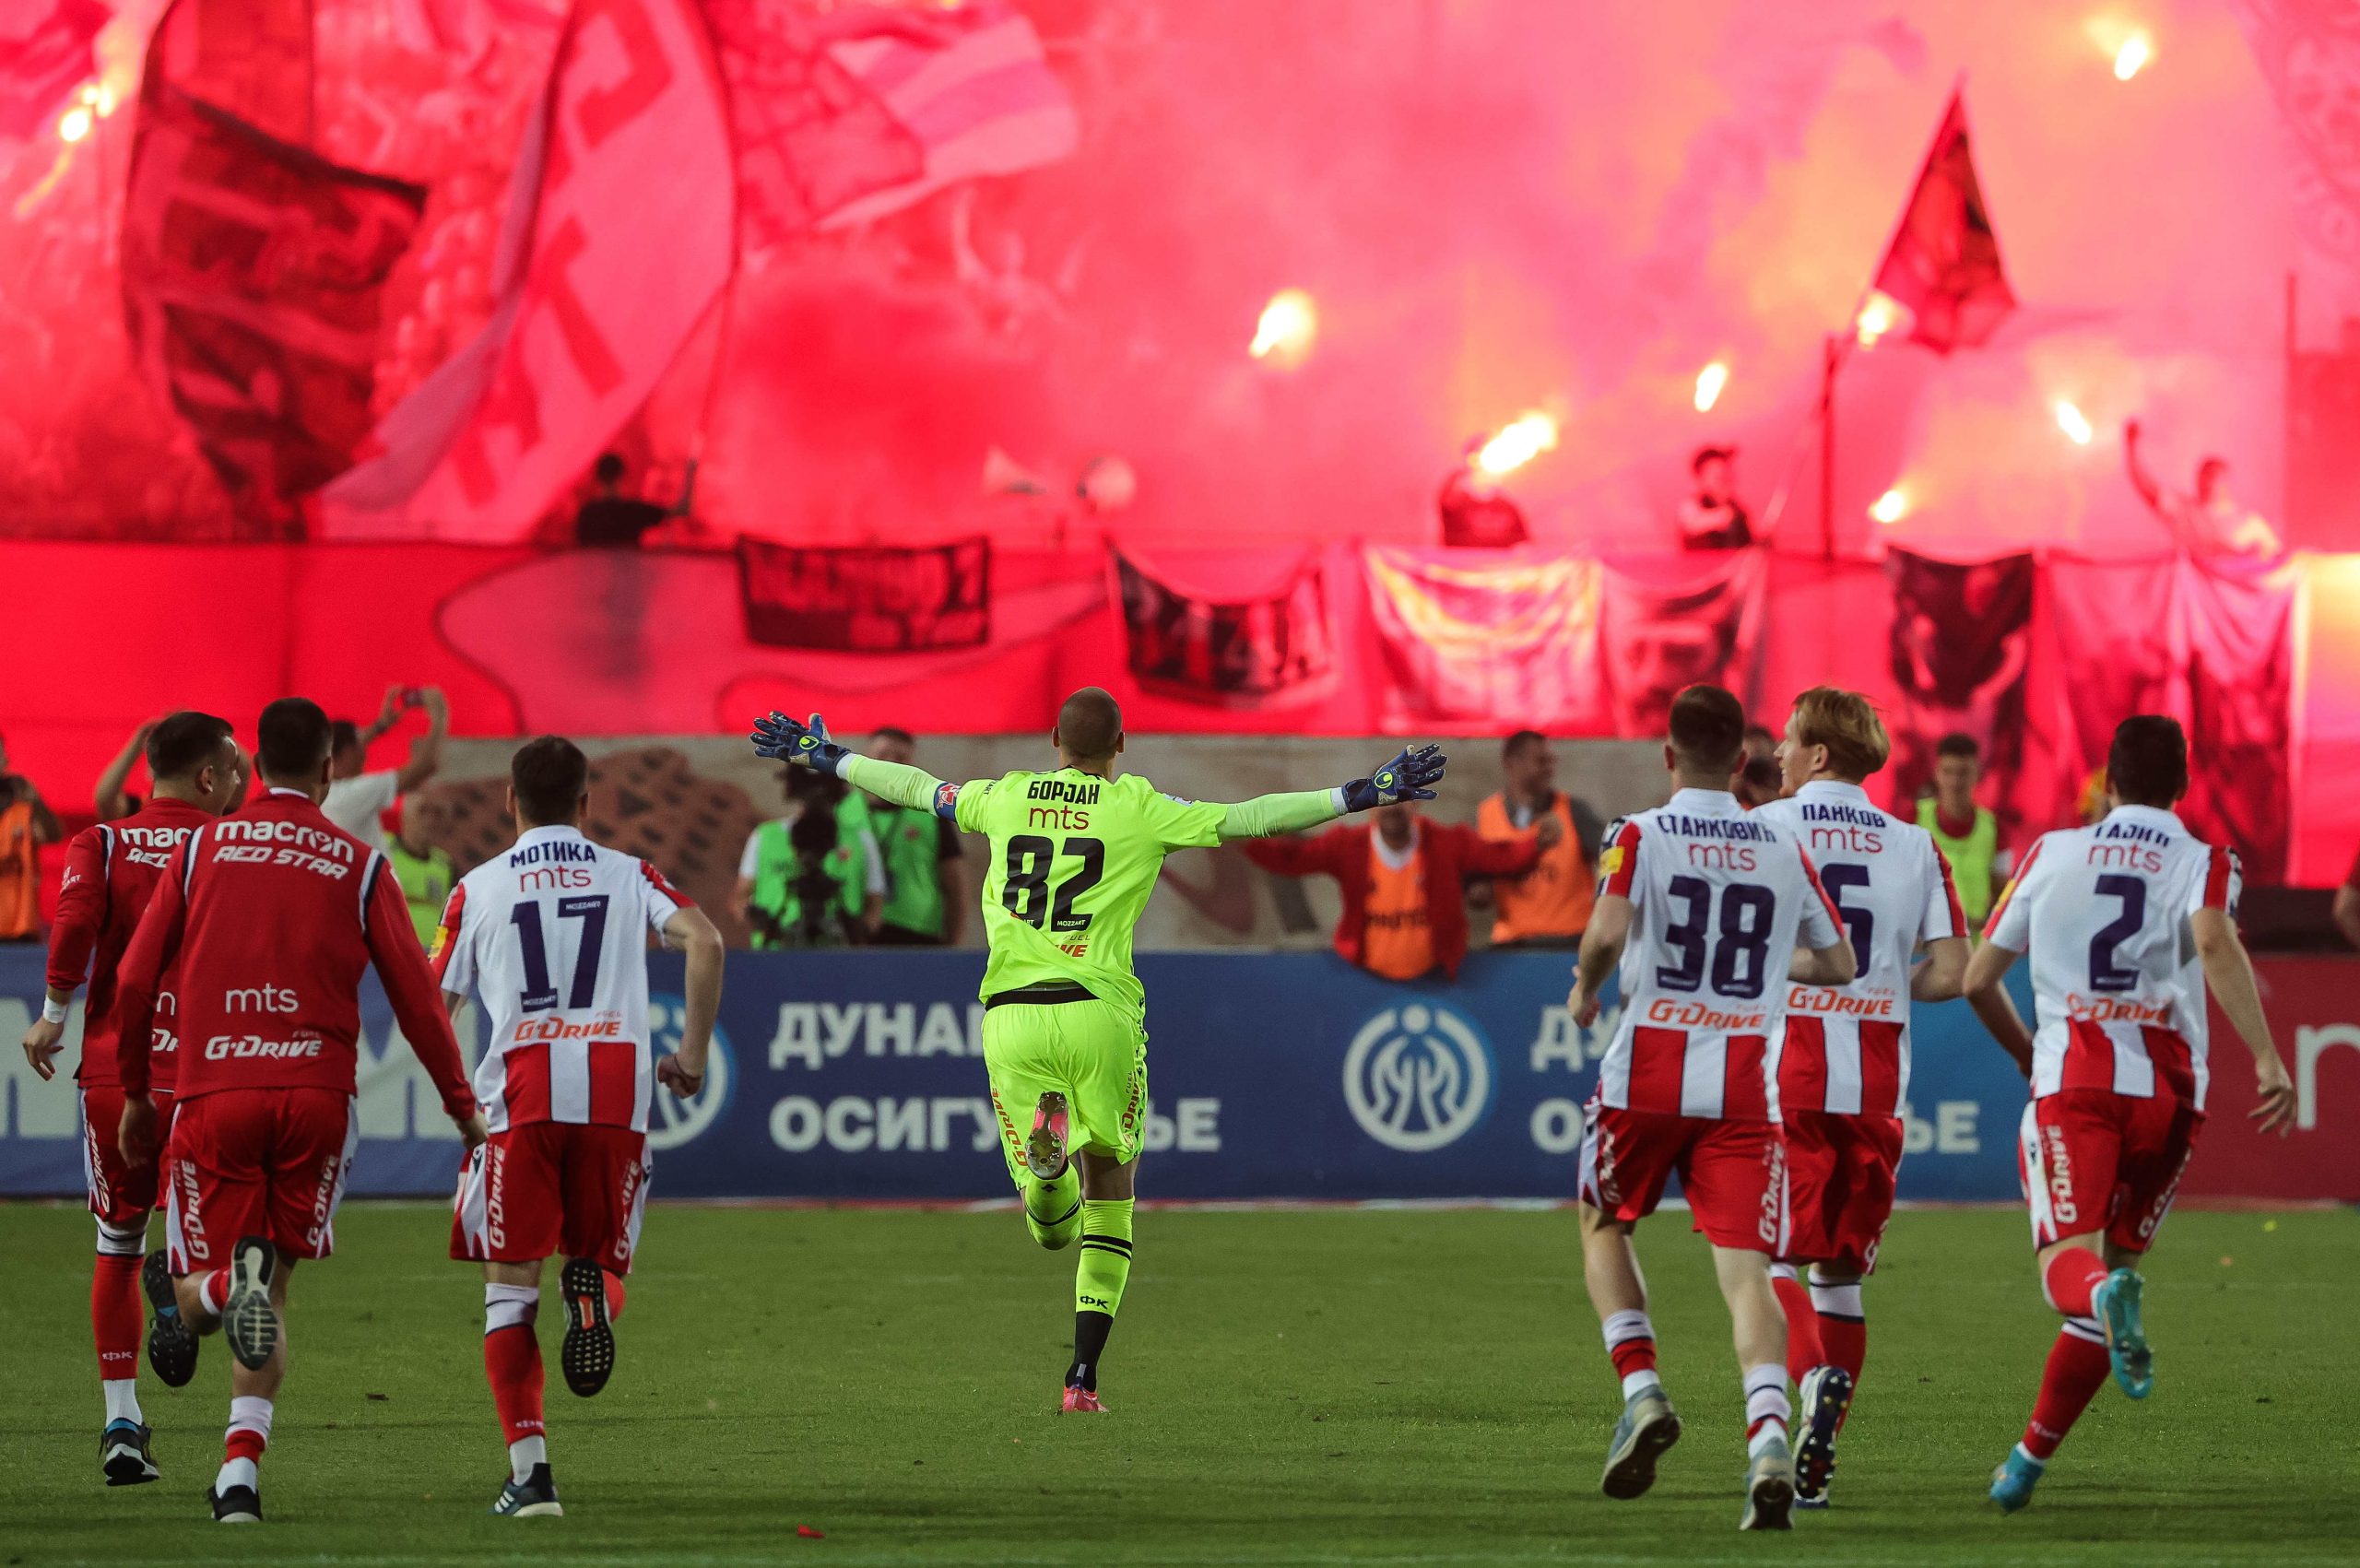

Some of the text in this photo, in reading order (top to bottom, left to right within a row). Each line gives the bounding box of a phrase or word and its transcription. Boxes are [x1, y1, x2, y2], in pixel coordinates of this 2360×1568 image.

[1027, 781, 1100, 805] БОРЈАН
[1029, 805, 1090, 830] mts
[1802, 804, 1885, 828] ПАНКОВ
[120, 827, 192, 848] mac
[215, 820, 354, 863] macron
[1811, 826, 1884, 854] mts
[212, 845, 348, 880] RED STAR
[510, 841, 597, 868] МОТИКА
[1689, 842, 1756, 872] mts
[2087, 843, 2163, 874] mts
[520, 865, 592, 891] mts
[1002, 835, 1105, 932] 82
[1056, 919, 1086, 927] MOZZART
[1657, 875, 1776, 1000] 38
[2089, 874, 2146, 991] 2
[510, 894, 609, 1013] 17
[226, 983, 299, 1013] mts
[1080, 1295, 1108, 1310] ФК
